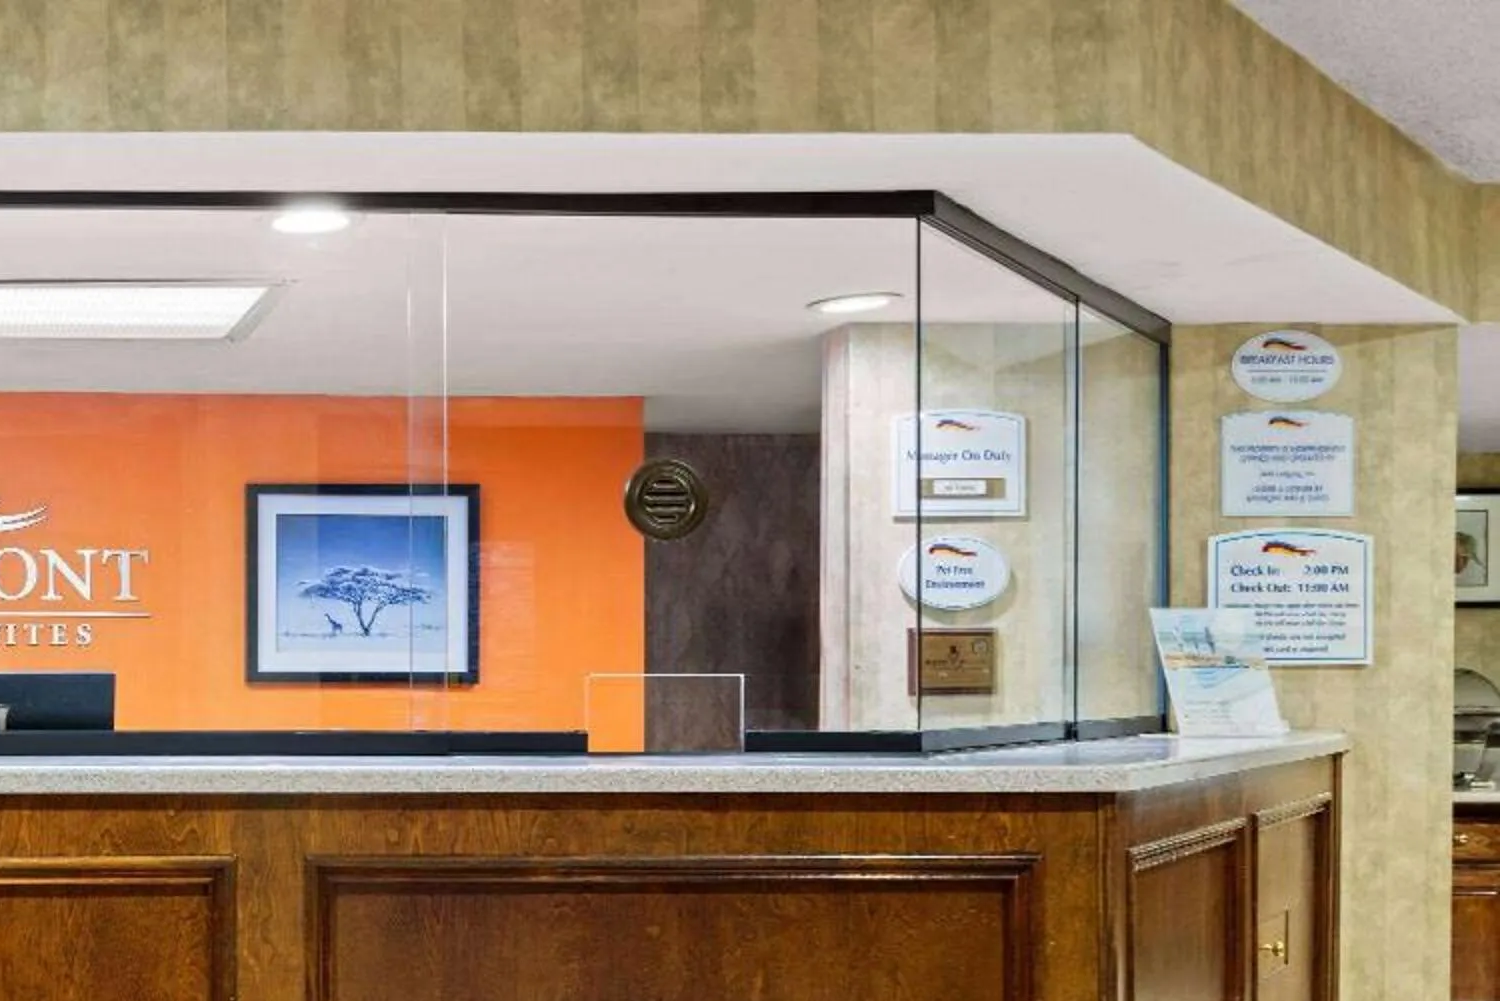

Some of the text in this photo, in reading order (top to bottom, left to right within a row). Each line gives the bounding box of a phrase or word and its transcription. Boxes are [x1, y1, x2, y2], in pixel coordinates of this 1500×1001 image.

[1240, 354, 1335, 365] BREAKFAST HOURS
[961, 449, 981, 461] On
[983, 449, 1012, 463] Duty
[1230, 565, 1263, 576] Check
[1331, 565, 1349, 575] PM
[1230, 583, 1264, 593] Check
[1330, 583, 1349, 593] AM
